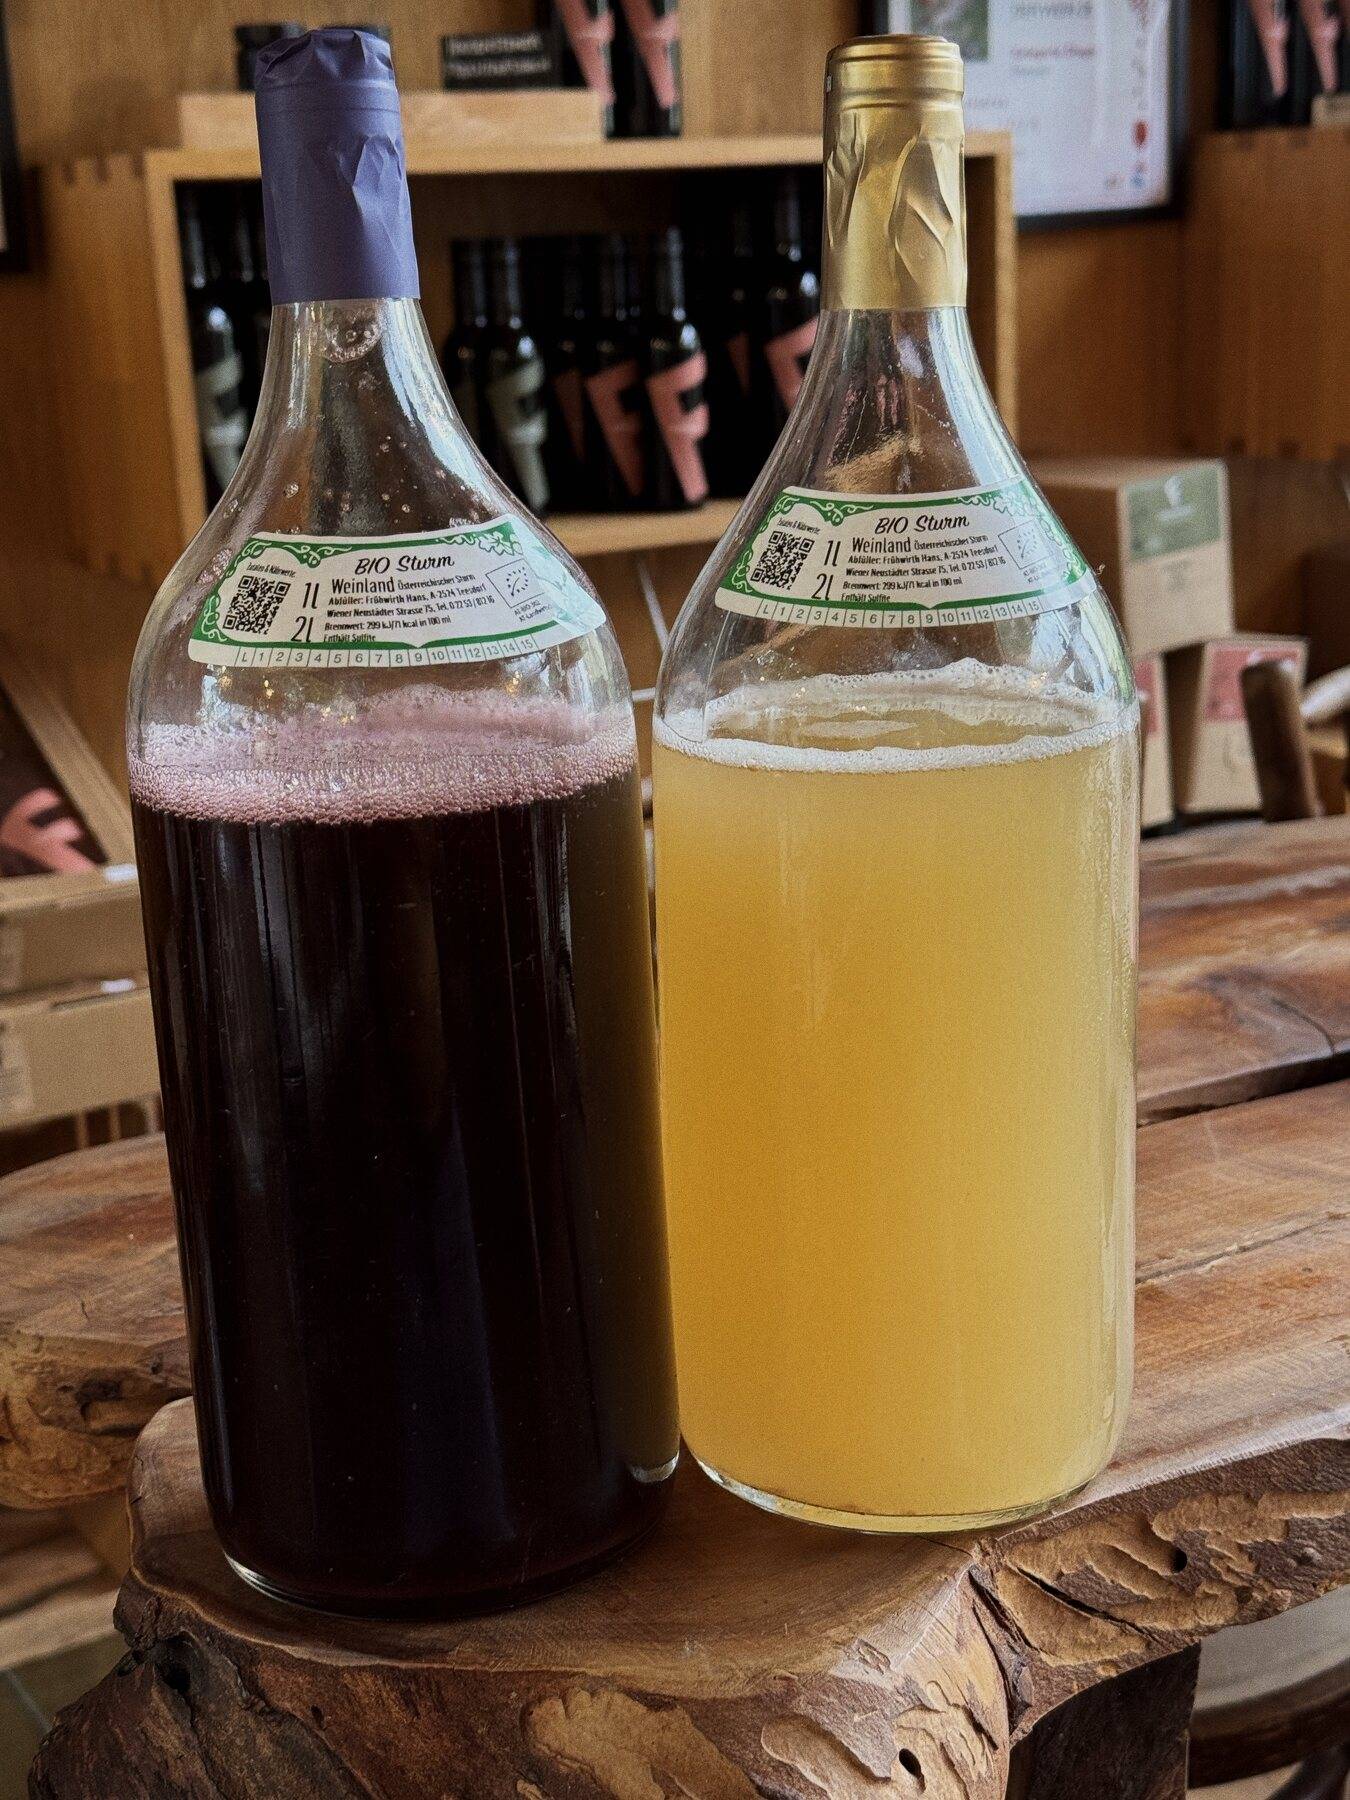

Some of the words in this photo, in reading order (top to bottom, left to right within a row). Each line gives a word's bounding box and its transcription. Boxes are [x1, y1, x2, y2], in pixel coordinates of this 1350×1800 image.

[874, 516, 909, 535] BIO
[914, 514, 970, 532] Sturm
[852, 536, 912, 554] Weinland
[914, 537, 969, 551] Österreichischer
[354, 557, 391, 575] BIO
[396, 555, 455, 572] Sturm
[848, 555, 881, 565] Abfüller:
[883, 554, 920, 565] Frühwirth
[921, 553, 943, 562] Hans,
[846, 567, 870, 577] Wiener
[870, 567, 910, 577] Neustädter
[910, 567, 937, 576] Strasse
[331, 576, 396, 594] Weinland
[397, 577, 455, 590] Österreichischer
[916, 580, 931, 588] kcal
[940, 577, 953, 586] 100
[953, 576, 963, 585] ml
[328, 596, 364, 606] Abfüller:
[366, 594, 405, 605] Frühwirth
[406, 594, 429, 602] Hans,
[841, 593, 867, 602] Enthält
[867, 593, 891, 602] Sulfite
[327, 608, 352, 618] Wiener
[353, 607, 395, 617] Neustädter
[396, 607, 423, 616] Strasse
[780, 606, 786, 616] 1
[796, 608, 805, 619] 2
[814, 610, 822, 620] 3
[831, 612, 839, 622] 4
[850, 613, 858, 623] 5
[869, 613, 877, 624] 6
[888, 614, 896, 624] 7
[907, 614, 915, 624] 8
[925, 613, 933, 624] 9
[941, 612, 954, 623] 10
[961, 611, 972, 621] 11
[978, 609, 990, 619] 12
[996, 607, 1008, 618] 13
[1011, 604, 1023, 614] 14
[1028, 601, 1040, 611] 15
[402, 619, 418, 629] kcal
[419, 619, 428, 627] in
[428, 616, 440, 625] 100
[441, 615, 451, 624] ml
[324, 634, 351, 643] Enthält
[352, 634, 376, 643] Sulfite
[259, 652, 264, 661] 1
[275, 651, 285, 662] 2
[294, 652, 303, 662] 3
[314, 653, 322, 662] 4
[334, 653, 342, 663] 5
[355, 653, 363, 663] 6
[375, 654, 383, 663] 7
[395, 653, 403, 664] 8
[414, 652, 423, 662] 9
[432, 650, 445, 661] 10
[451, 649, 461, 659] 11
[469, 647, 481, 658] 12
[487, 645, 499, 656] 13
[503, 642, 515, 653] 14
[520, 639, 534, 650] 15
